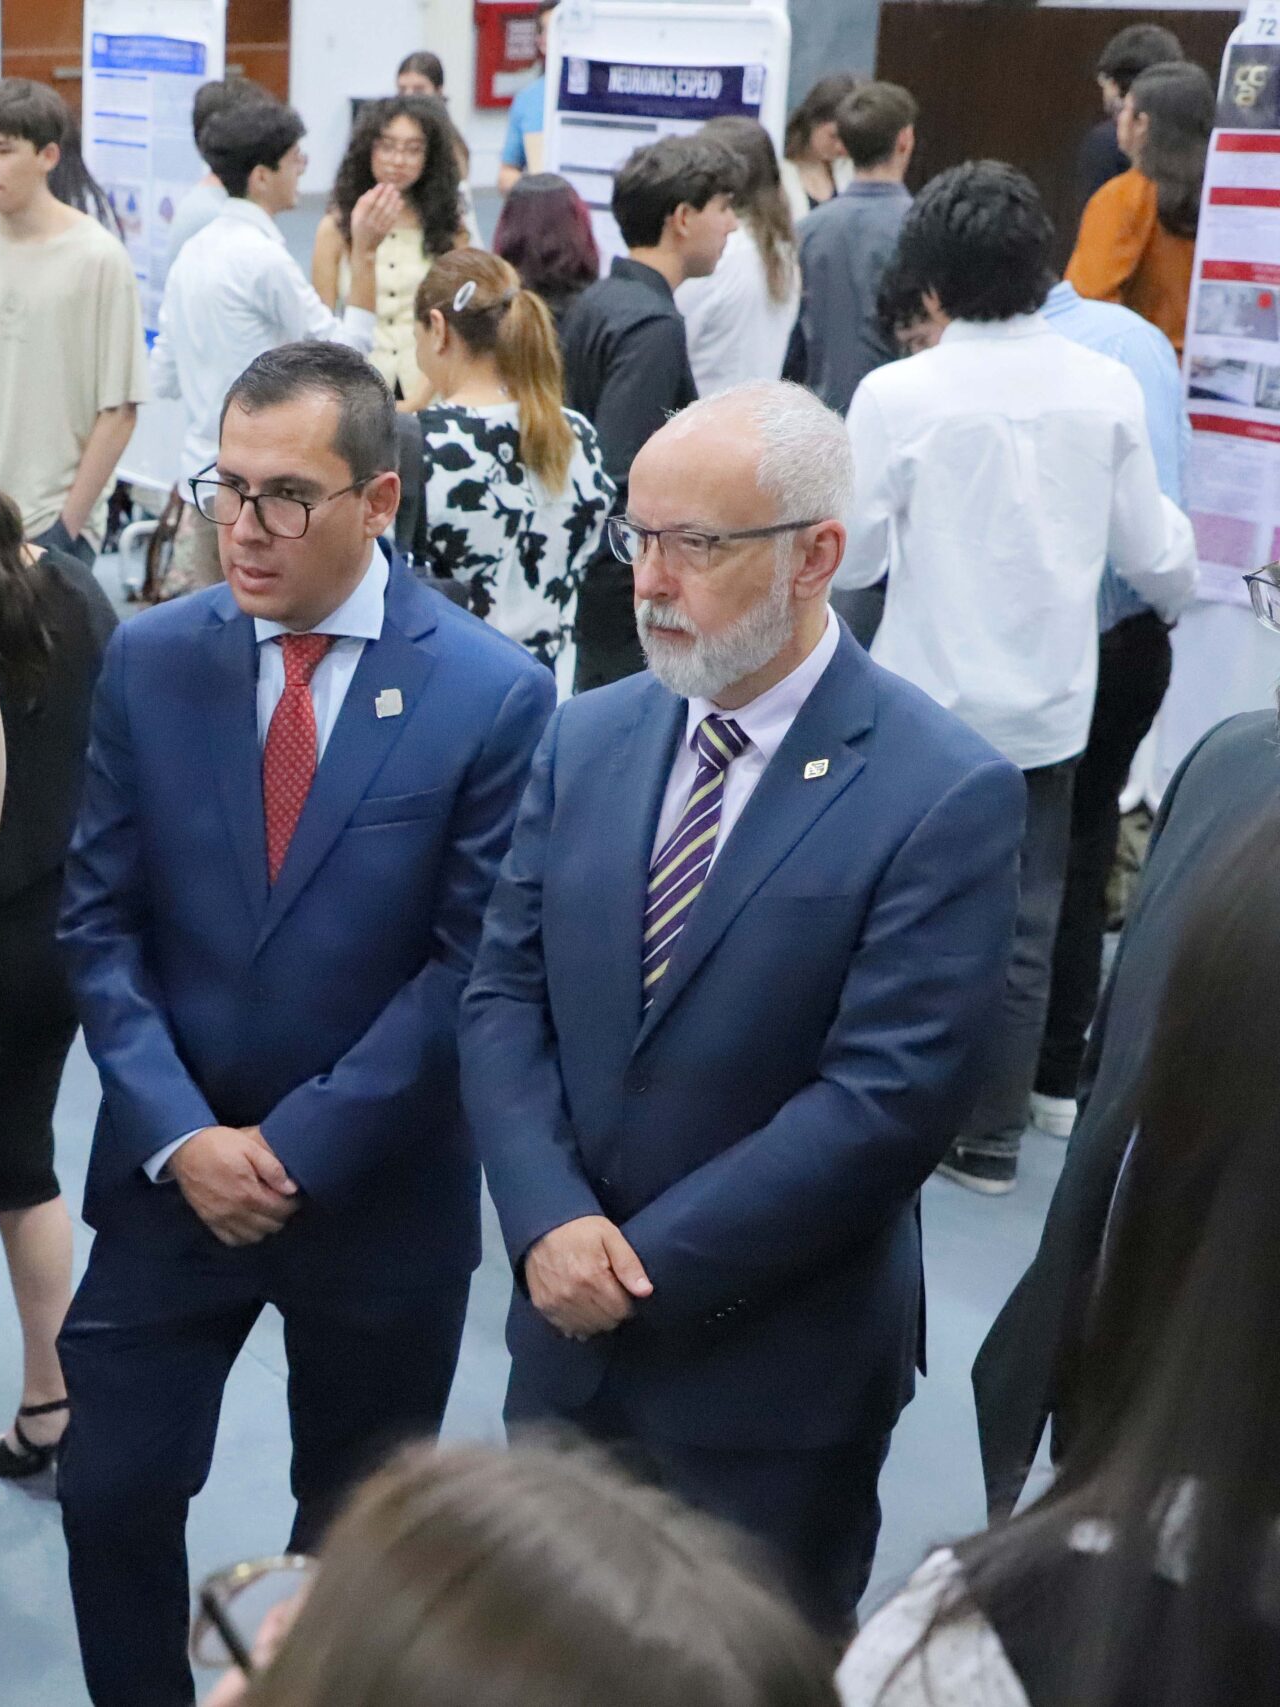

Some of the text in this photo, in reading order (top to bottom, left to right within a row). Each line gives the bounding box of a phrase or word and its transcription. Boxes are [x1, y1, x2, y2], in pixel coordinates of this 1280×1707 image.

[1257, 17, 1277, 36] 72
[608, 65, 675, 97] NEURONAS
[675, 68, 723, 100] ESPEJO
